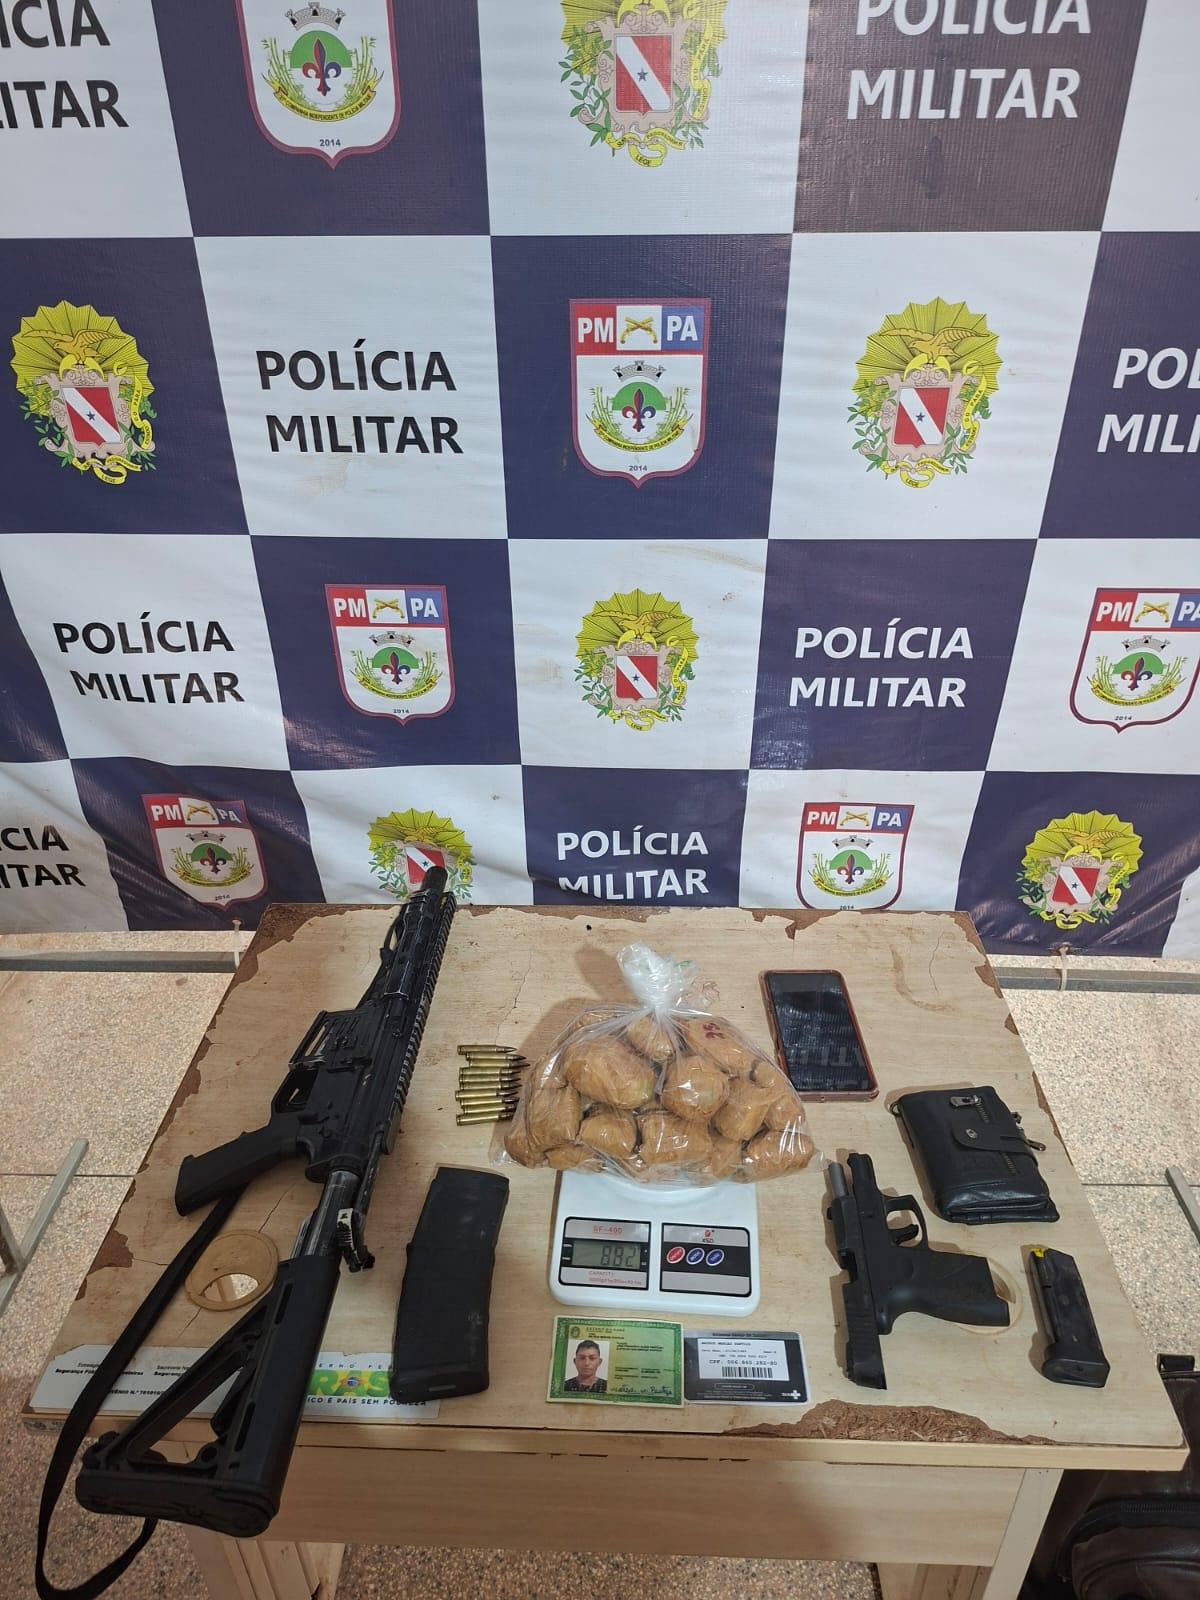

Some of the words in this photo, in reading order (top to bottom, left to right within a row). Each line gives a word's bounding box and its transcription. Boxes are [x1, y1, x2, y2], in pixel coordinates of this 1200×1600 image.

[0, 80, 129, 128] ITAR
[847, 68, 1080, 120] MILITAR
[319, 139, 341, 147] 2014
[577, 317, 614, 343] PM
[666, 315, 698, 342] PA
[256, 338, 457, 391] POLÍCIA
[266, 415, 464, 454] MILITAR
[333, 598, 367, 618] PM
[410, 598, 439, 618] PA
[1096, 601, 1133, 622] PM
[53, 612, 235, 654] POLÍCIA
[795, 617, 974, 659] POLÍCIA
[70, 670, 245, 703] MILITAR
[789, 677, 967, 707] MILITAR
[150, 804, 182, 821] PM
[216, 808, 242, 824] PA
[807, 811, 837, 825] PM
[877, 812, 902, 827] PA
[557, 825, 709, 860] POLÍCIA
[559, 868, 709, 900] MILITAR
[601, 1245, 637, 1267] 882
